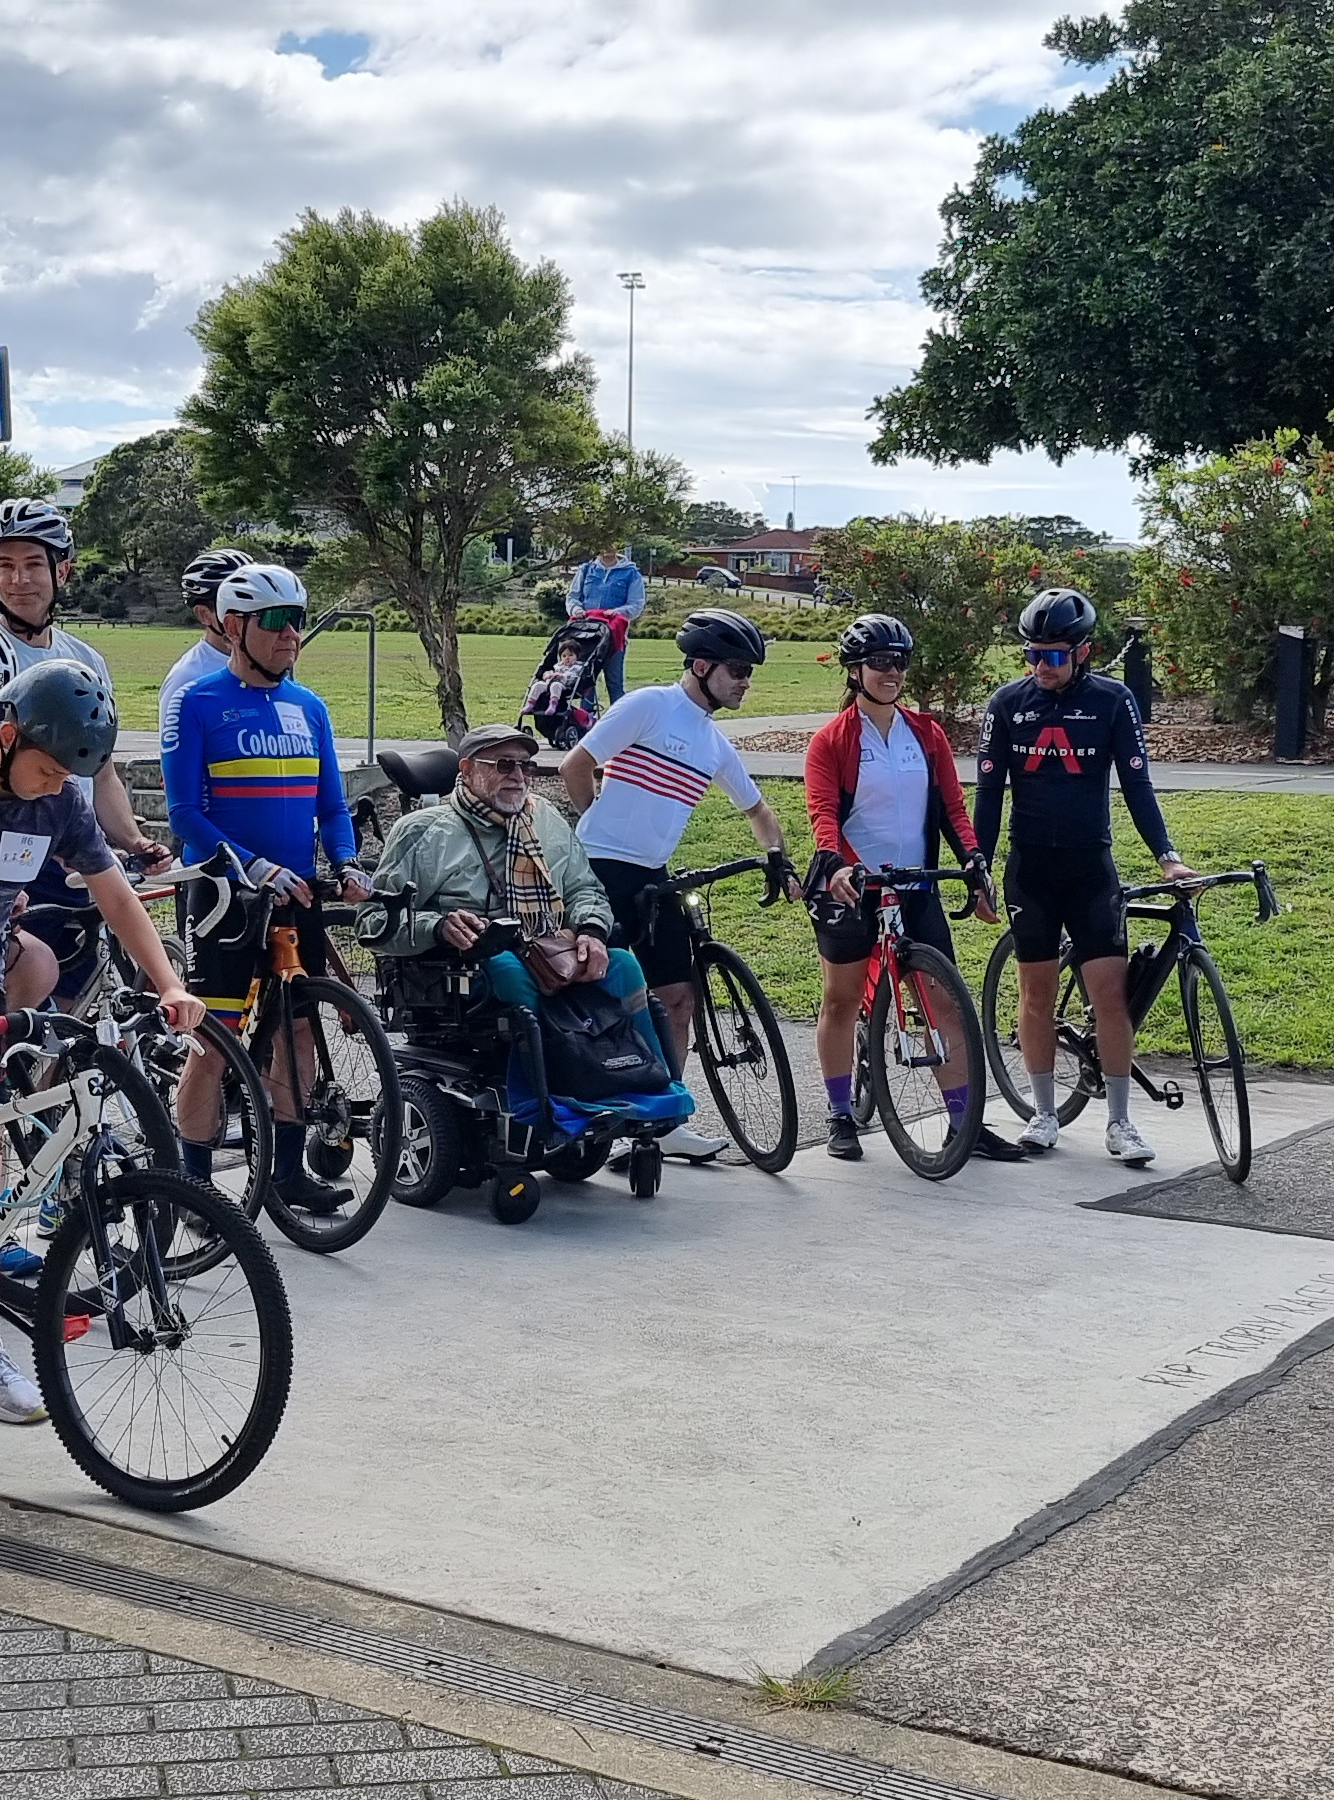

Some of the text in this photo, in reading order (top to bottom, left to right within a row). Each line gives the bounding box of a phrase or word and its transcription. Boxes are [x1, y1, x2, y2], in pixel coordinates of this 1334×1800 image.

[978, 711, 996, 754] INEOS
[1012, 743, 1097, 757] GRENADIER
[20, 836, 35, 847] #6
[184, 914, 197, 973] Colombia
